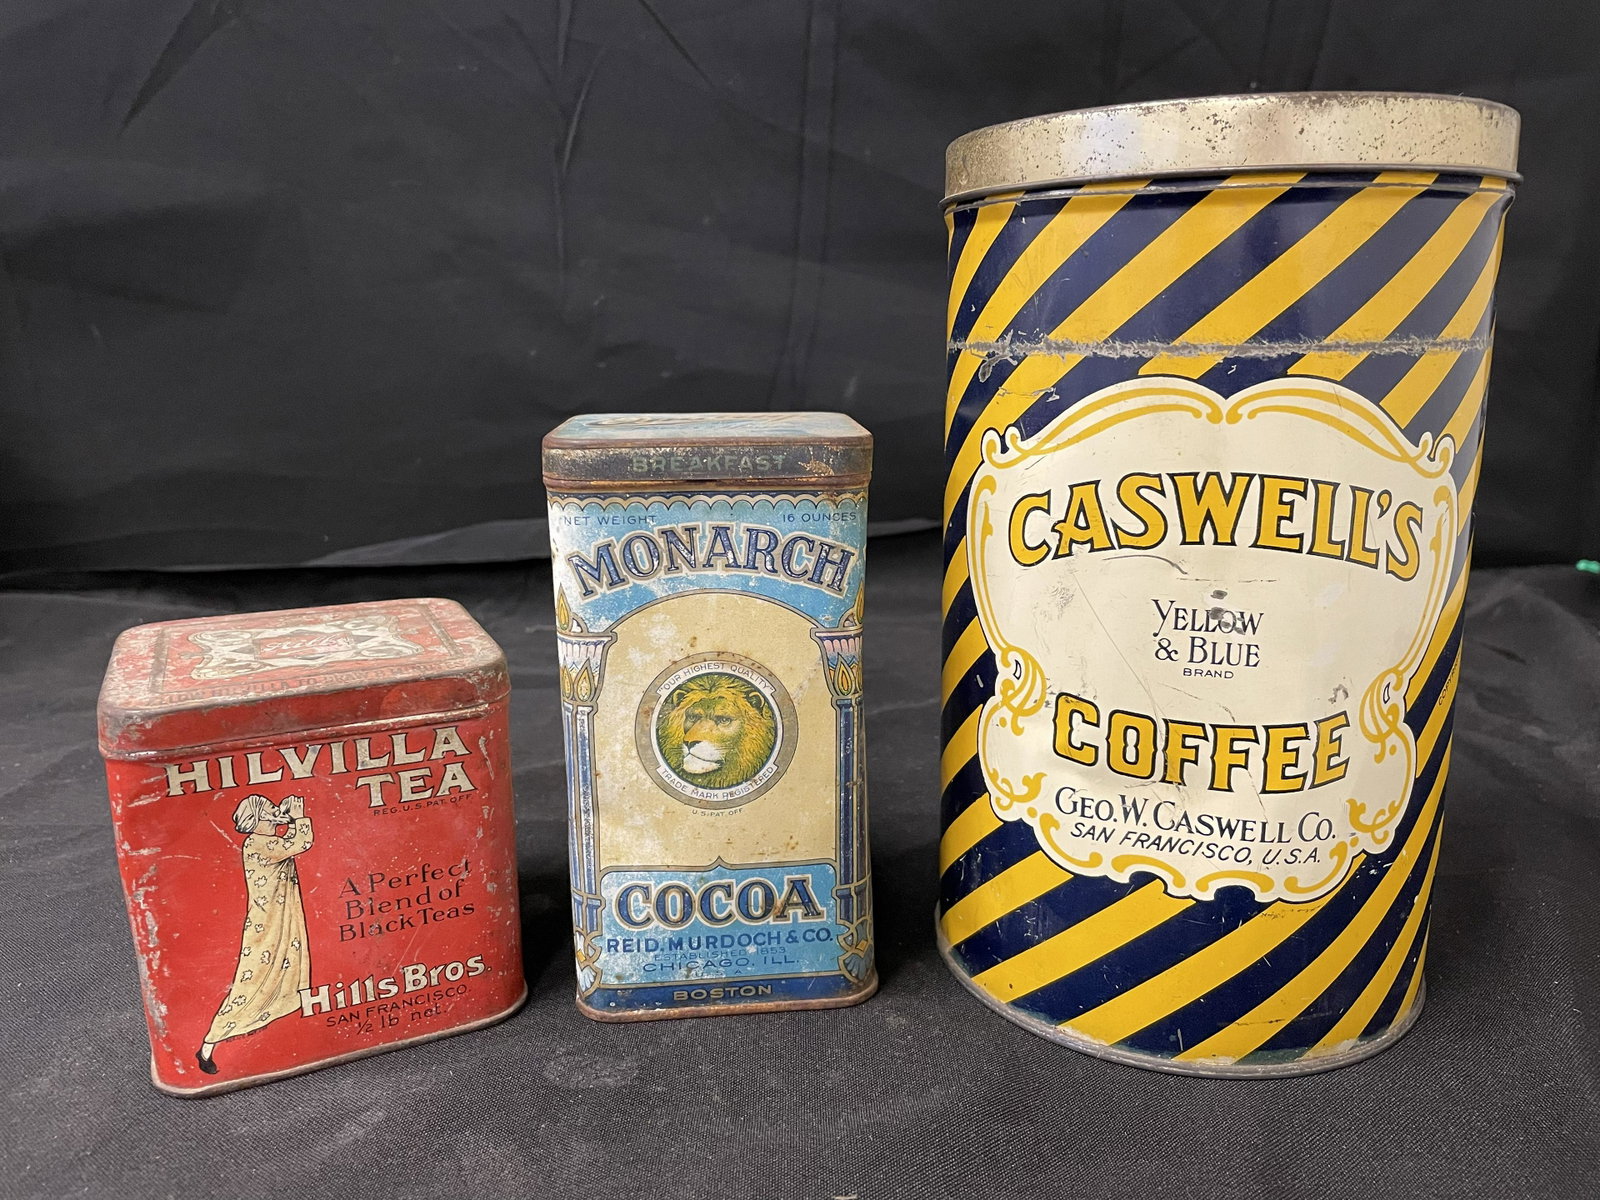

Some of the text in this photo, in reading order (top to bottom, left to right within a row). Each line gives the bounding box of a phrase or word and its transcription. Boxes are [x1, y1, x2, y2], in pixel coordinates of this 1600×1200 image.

[631, 453, 786, 473] BREAKFAST
[563, 514, 658, 526] NET WEIGHT
[782, 511, 857, 523] 16 OUNCES
[1007, 471, 1424, 582] CASWELL'S
[567, 525, 857, 597] MONARCH
[1154, 635, 1260, 668] & BLUE
[684, 663, 725, 676] HIGHEST
[1183, 669, 1234, 679] BRAND
[1054, 692, 1352, 793] COFFEE
[164, 727, 472, 797] HILVILLA
[355, 760, 477, 808] TEA
[661, 766, 774, 799] TRADE MARK REGISTERED
[1070, 822, 1321, 866] SAN FRANCISCO, U.S.A.
[338, 859, 472, 899] A Perfect
[345, 879, 465, 920] Blend of
[615, 879, 823, 928] COCOA
[339, 903, 475, 942] Black Teas
[668, 931, 782, 951] MURDOCH
[785, 930, 799, 944] &
[802, 927, 834, 943] CO.
[654, 946, 786, 962] ESTABLISHED 1853
[762, 955, 800, 965] ILL.
[298, 954, 493, 1018] Hills Bros.
[673, 985, 774, 1001] BOSTON
[326, 1010, 361, 1028] SAN
[381, 1014, 400, 1028] lb
[410, 1004, 447, 1022] net.
